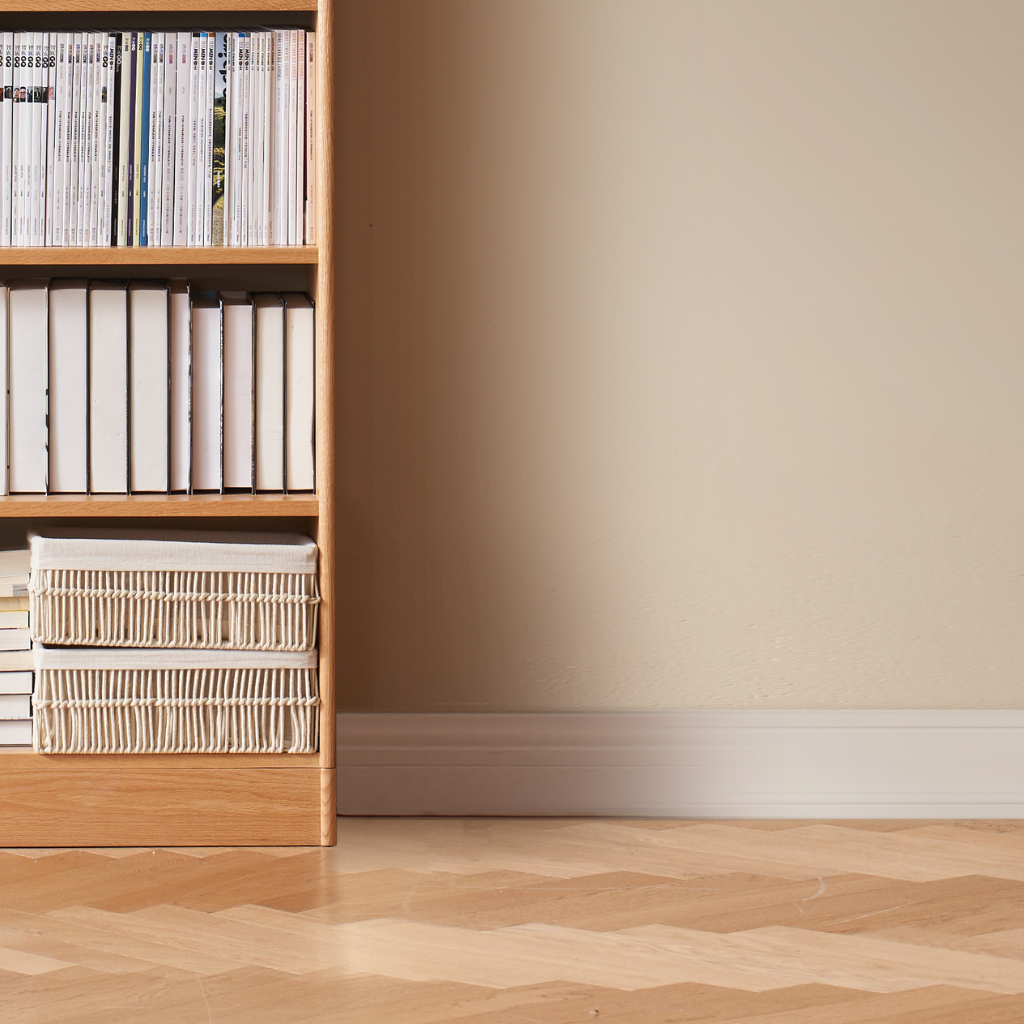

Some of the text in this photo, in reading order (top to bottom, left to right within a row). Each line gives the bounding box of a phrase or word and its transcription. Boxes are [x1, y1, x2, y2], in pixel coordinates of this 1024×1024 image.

[6, 56, 11, 67] GQ
[15, 57, 20, 67] GQ
[21, 56, 26, 67] GQ
[28, 57, 33, 67] GQ
[36, 57, 41, 67] GQ
[43, 57, 48, 68] GQ
[50, 56, 55, 67] GQ
[103, 57, 108, 67] GQ
